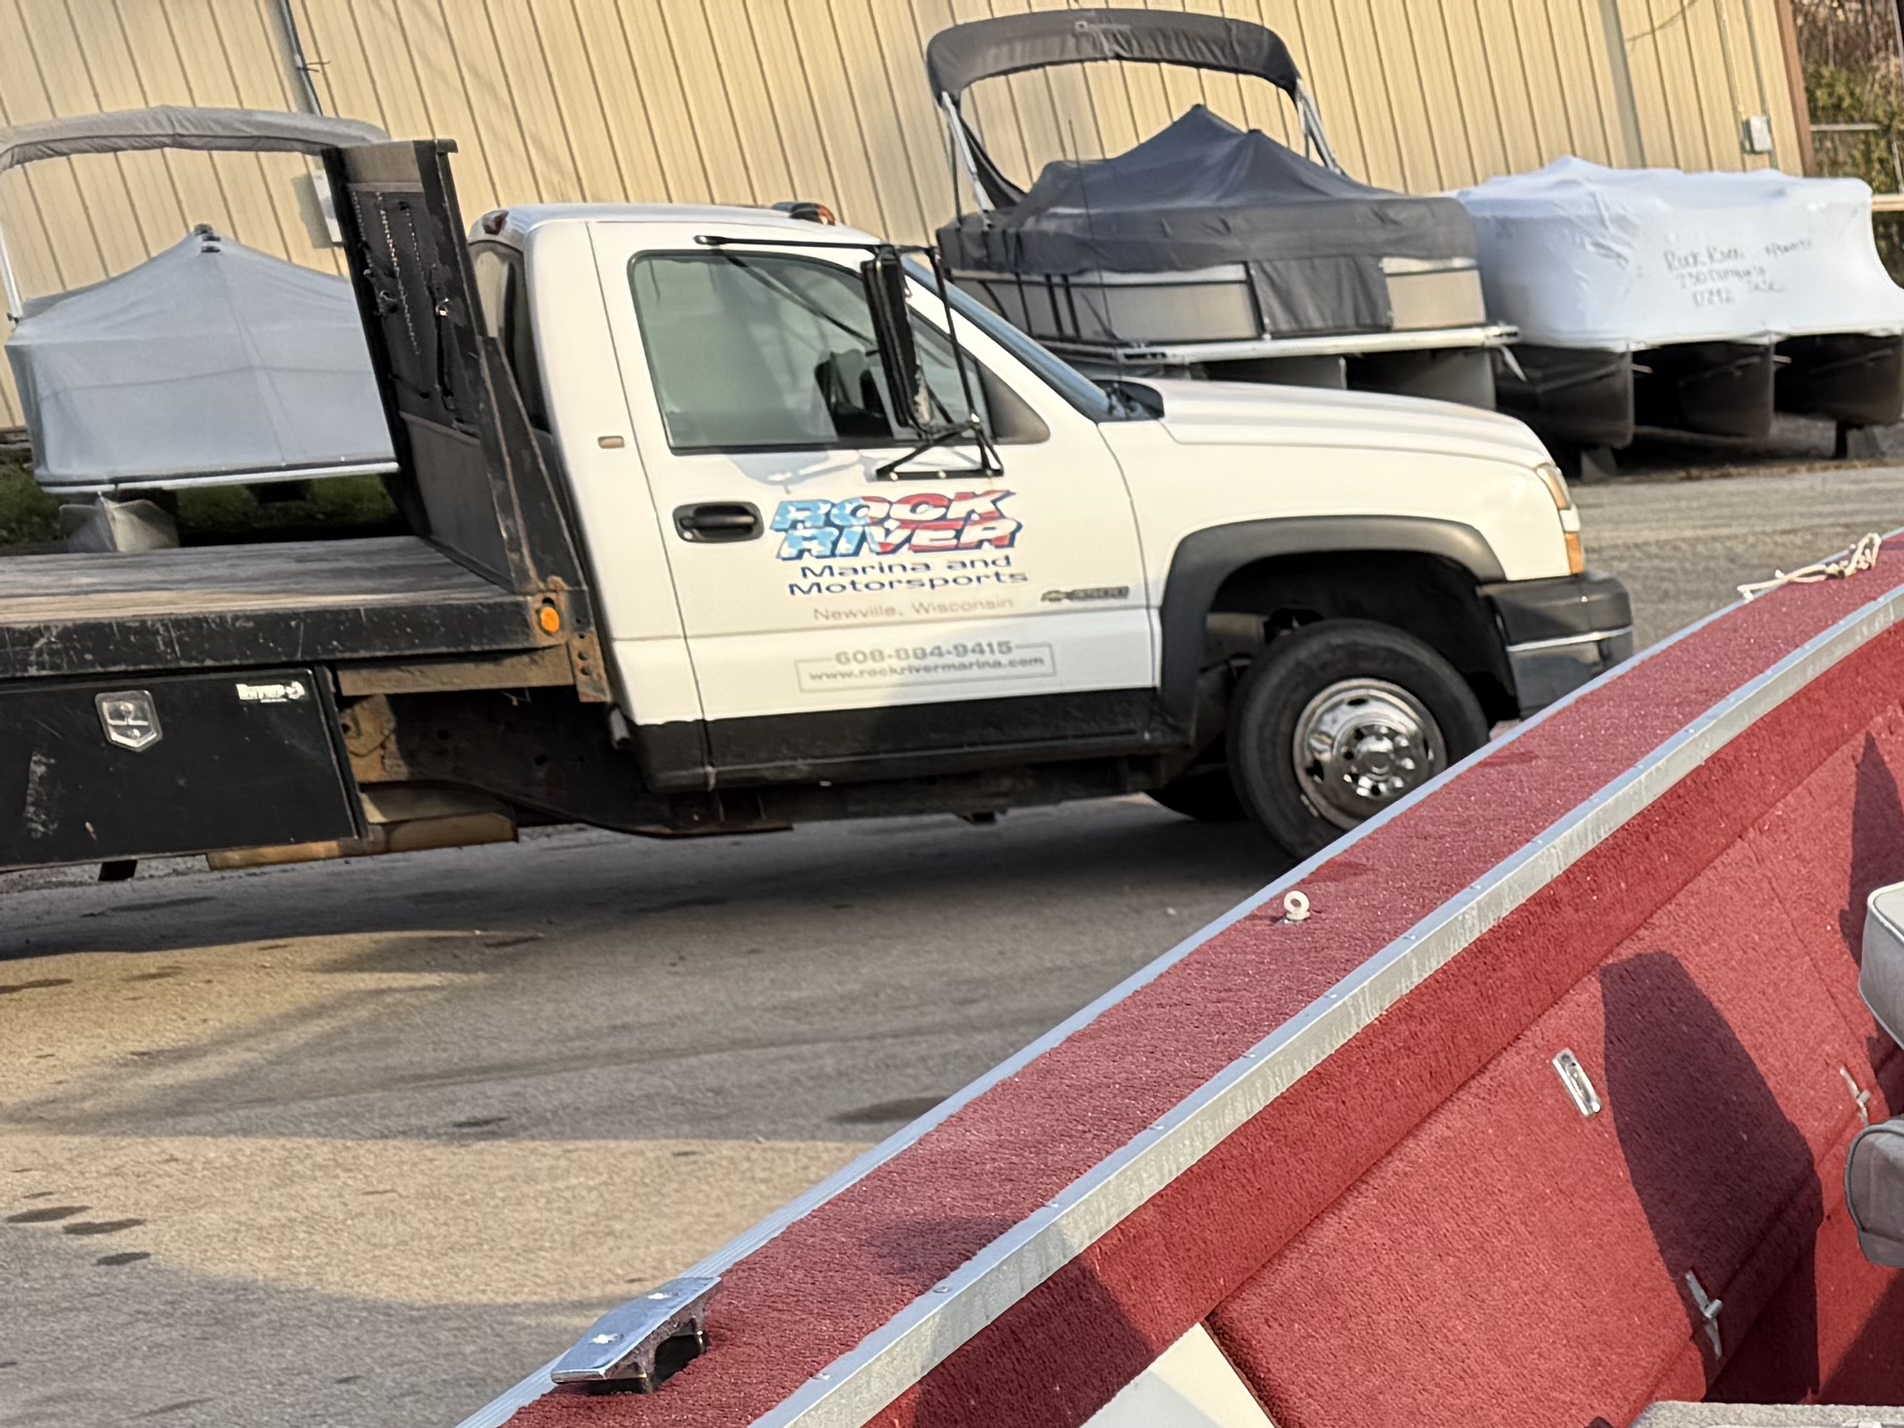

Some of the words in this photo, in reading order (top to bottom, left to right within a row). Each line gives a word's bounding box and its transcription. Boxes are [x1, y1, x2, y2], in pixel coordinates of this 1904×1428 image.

[770, 490, 1016, 532] ROCK
[777, 518, 1022, 560] RIVER
[800, 562, 931, 579] Marina
[946, 555, 1012, 571] and
[788, 571, 1029, 596] Motorsports
[911, 598, 1015, 615] Wisconsin
[808, 656, 1045, 681] www.rockrivermarina.com
